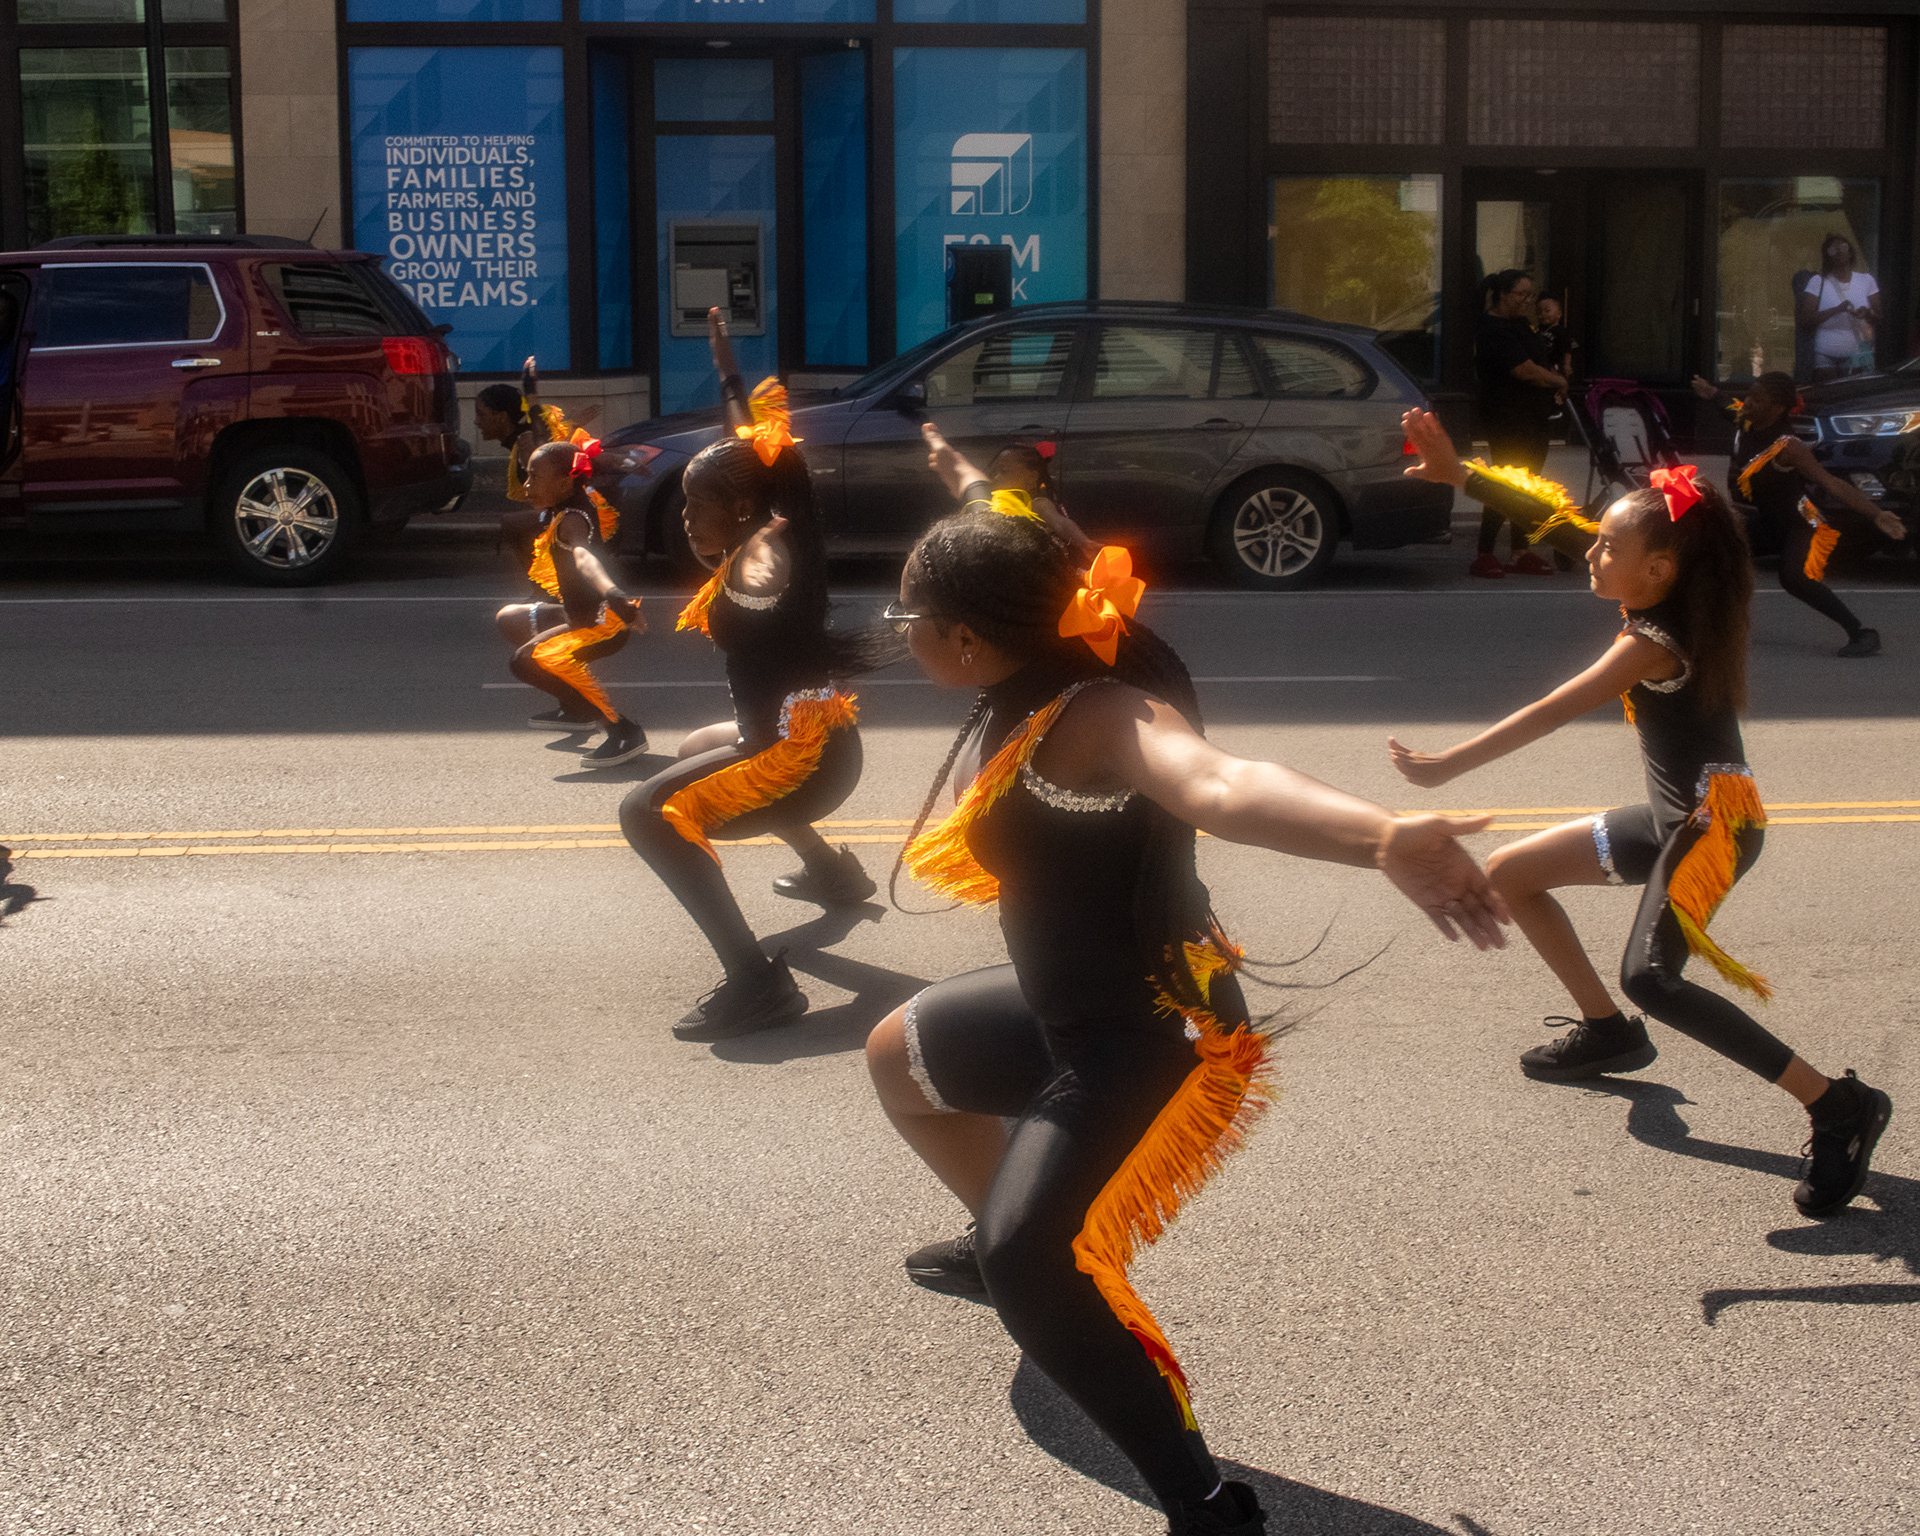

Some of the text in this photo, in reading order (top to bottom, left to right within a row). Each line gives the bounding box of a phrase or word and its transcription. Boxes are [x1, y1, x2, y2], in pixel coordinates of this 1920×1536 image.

[385, 135, 535, 147] COMMITTED TO HELPING
[386, 146, 535, 167] INDIVIDUALS,
[387, 167, 535, 190] FAMILIES,
[388, 191, 536, 210] FARMERS, AND
[388, 210, 536, 232] BUSINESS
[389, 232, 536, 260] OWNERS
[390, 260, 538, 280] GROW THEIR
